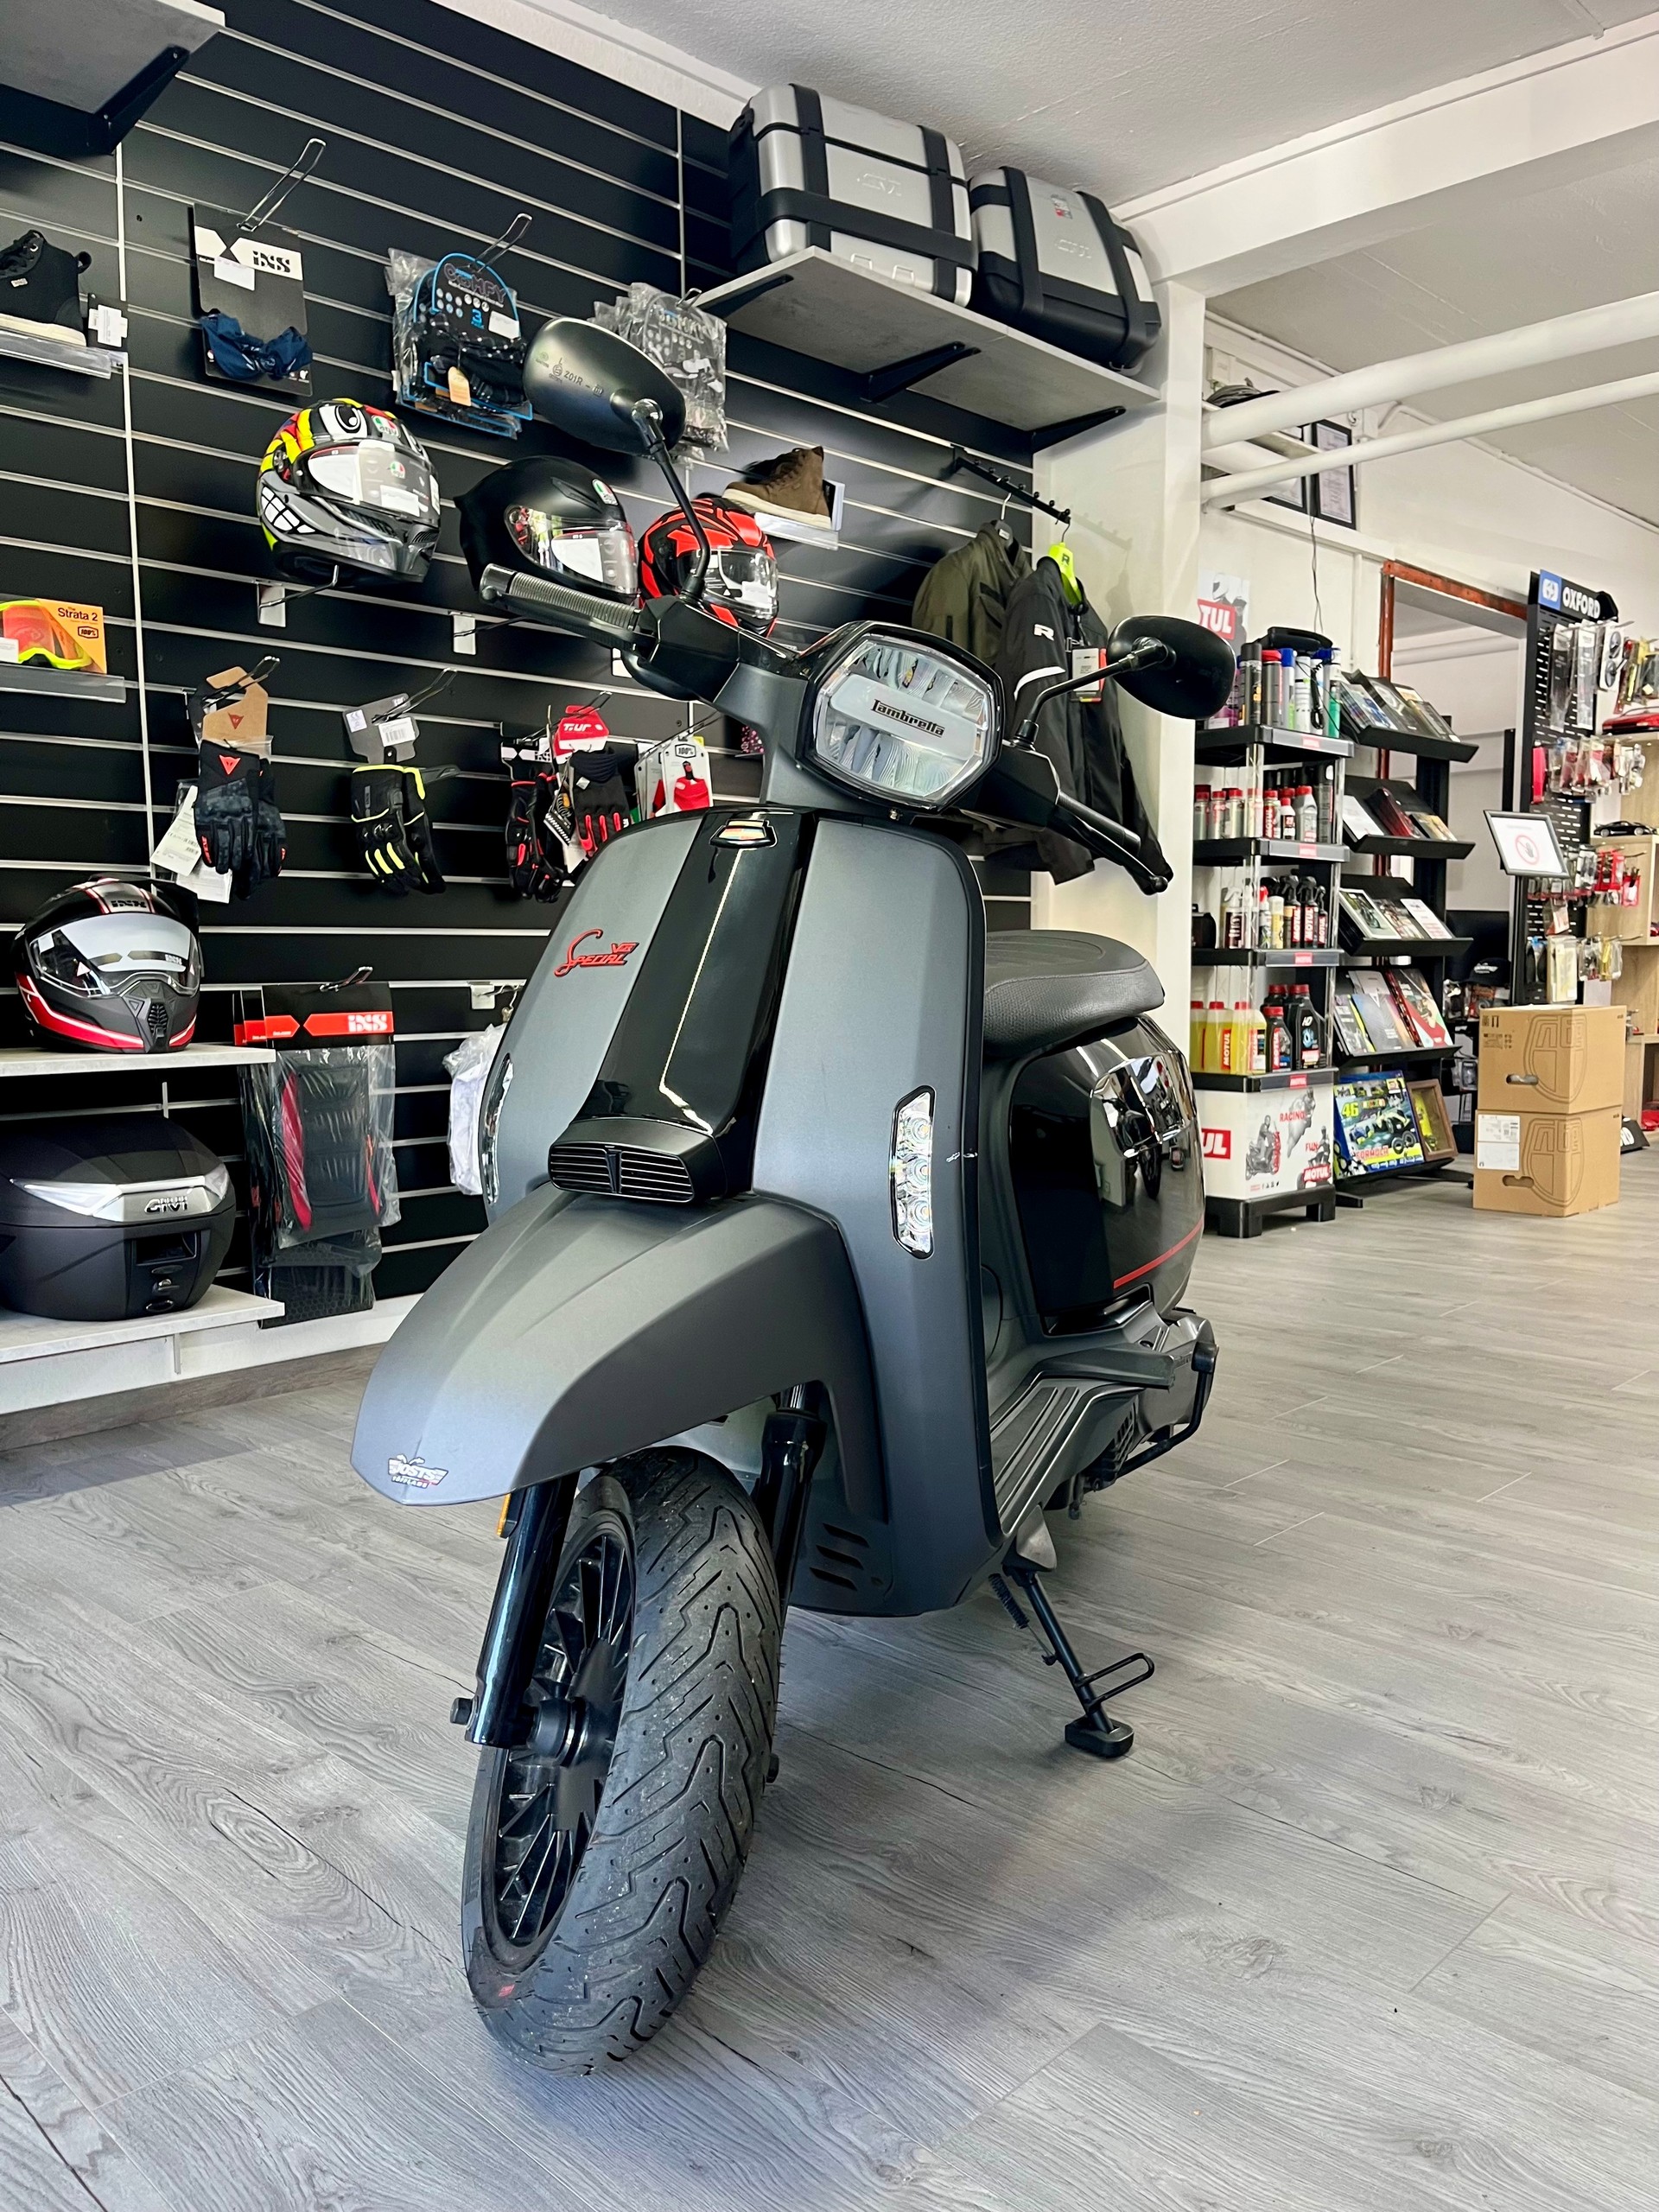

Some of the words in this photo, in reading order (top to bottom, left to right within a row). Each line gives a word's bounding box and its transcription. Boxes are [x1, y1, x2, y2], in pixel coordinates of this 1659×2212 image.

[1562, 587, 1600, 619] OXFORD
[58, 607, 89, 620] Strata
[92, 613, 99, 621] 2
[1034, 624, 1054, 641] R
[870, 698, 945, 738] Lambretta
[1293, 906, 1301, 942] MOTUL
[1305, 906, 1314, 941] MOTUL
[1302, 1015, 1313, 1027] HD
[1280, 1111, 1306, 1122] RACING
[1342, 1102, 1360, 1117] 46
[1201, 1130, 1227, 1155] UL
[1303, 1166, 1329, 1180] MOTUL
